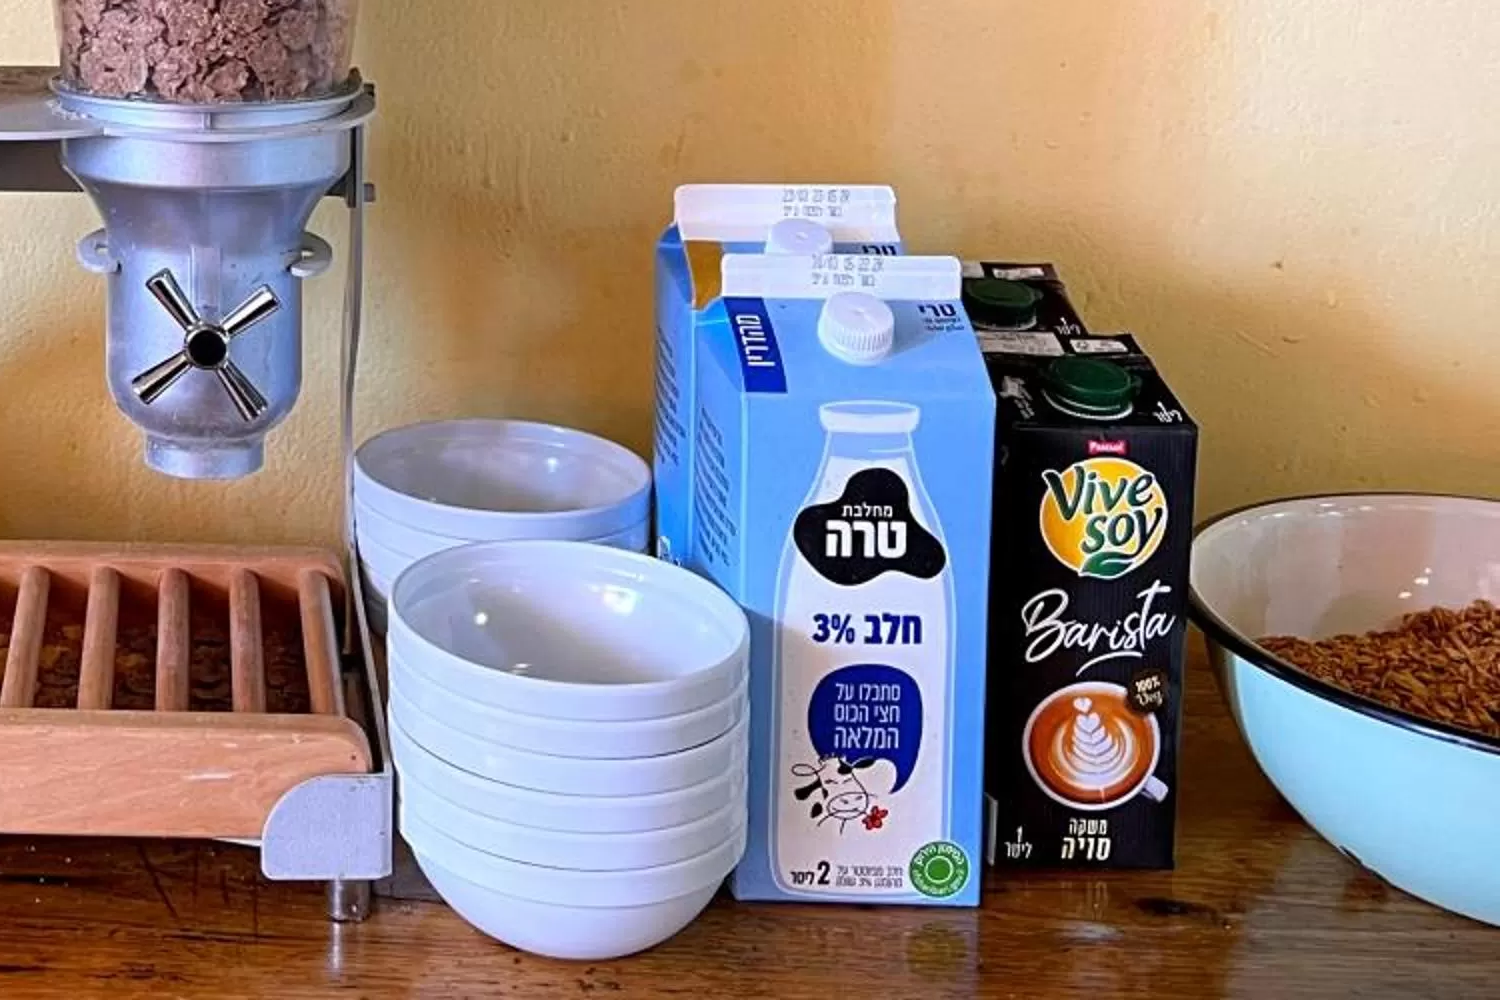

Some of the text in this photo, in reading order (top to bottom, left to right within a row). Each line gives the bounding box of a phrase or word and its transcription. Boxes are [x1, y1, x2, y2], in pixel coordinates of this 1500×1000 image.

[917, 303, 956, 317] טרי
[735, 314, 776, 367] מהדרין
[1041, 465, 1155, 521] Vive
[842, 502, 893, 517] מחלבת
[826, 520, 907, 558] טרה
[1080, 506, 1163, 556] soy
[812, 612, 922, 645] חלב 3%
[1021, 579, 1177, 664] Barista
[835, 682, 855, 701] על
[833, 703, 901, 723] חצי הכוס
[833, 726, 899, 749] המלאה
[1068, 817, 1108, 837] משקה
[1003, 841, 1033, 859] ליטר
[1061, 837, 1111, 861] סויה
[790, 870, 815, 886] ליטר
[817, 860, 831, 886] 2
